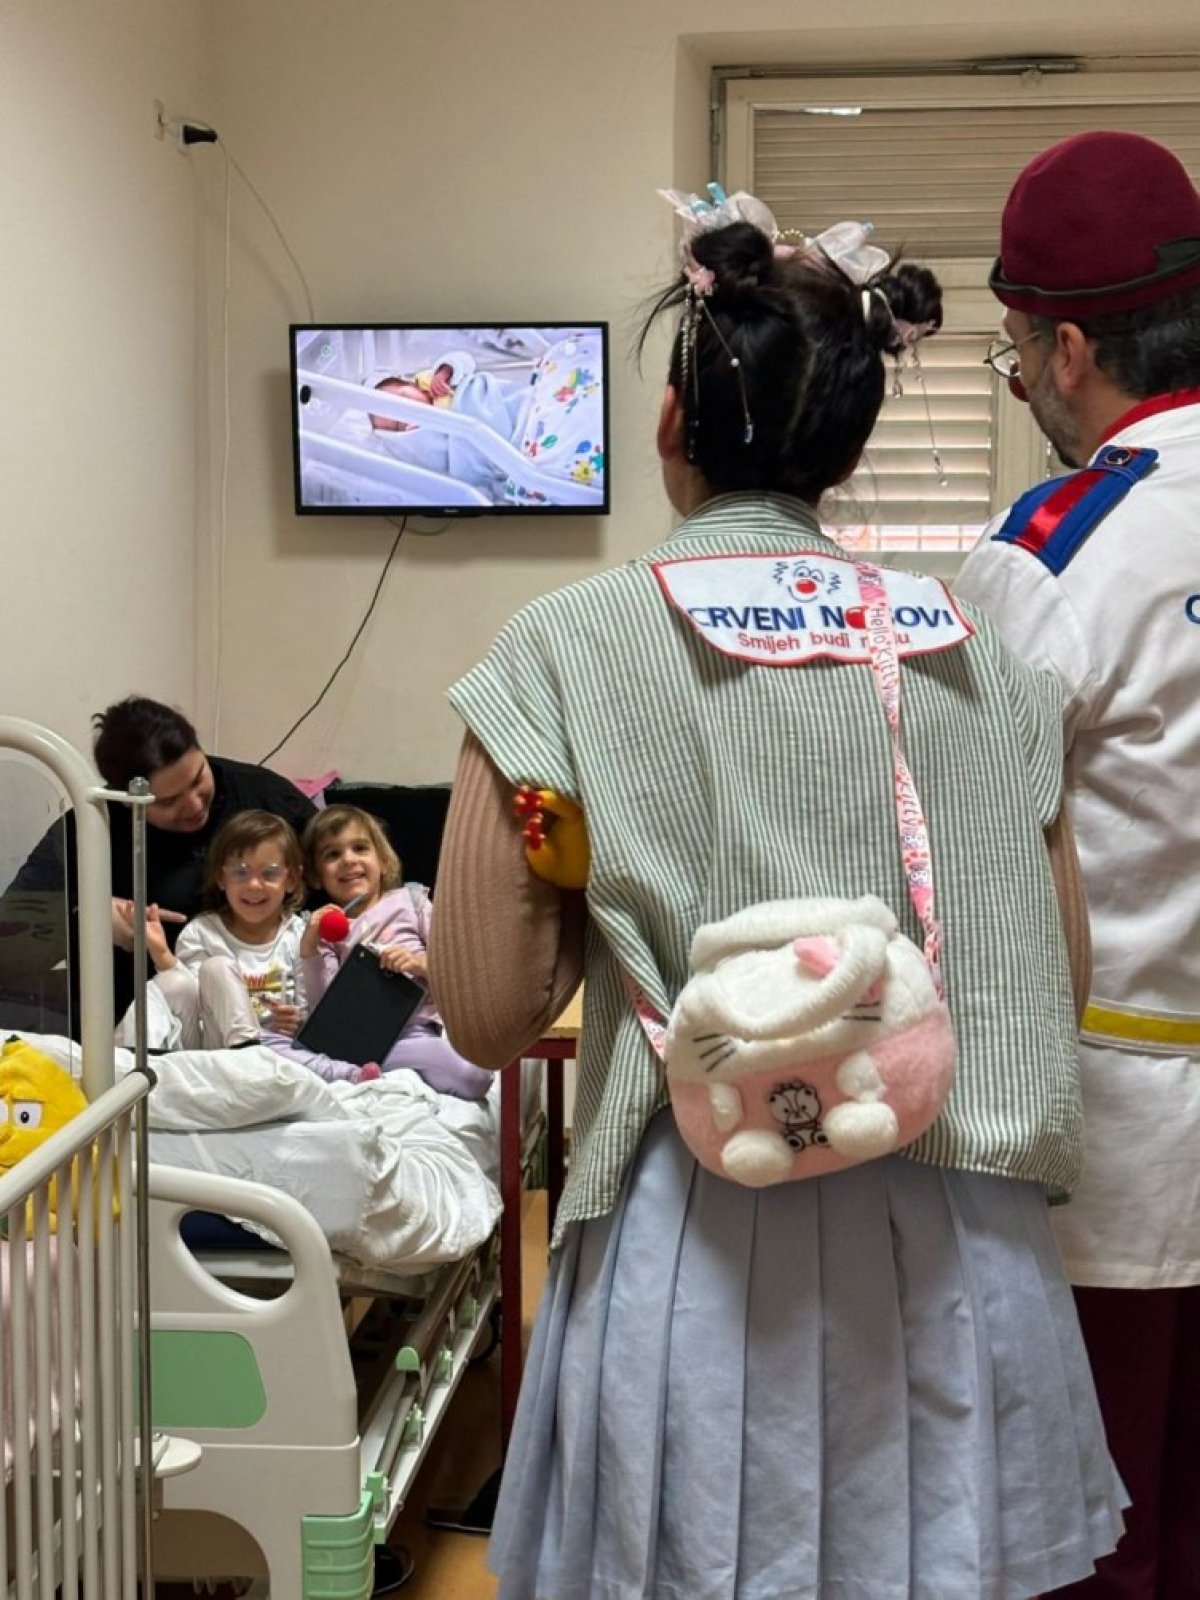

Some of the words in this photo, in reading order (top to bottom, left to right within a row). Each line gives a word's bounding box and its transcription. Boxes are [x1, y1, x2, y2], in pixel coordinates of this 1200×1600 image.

[688, 606, 806, 630] CRVENI
[819, 605, 954, 629] NOOVI
[868, 606, 890, 644] Hello
[738, 632, 800, 654] Smijeh
[810, 631, 850, 648] budi
